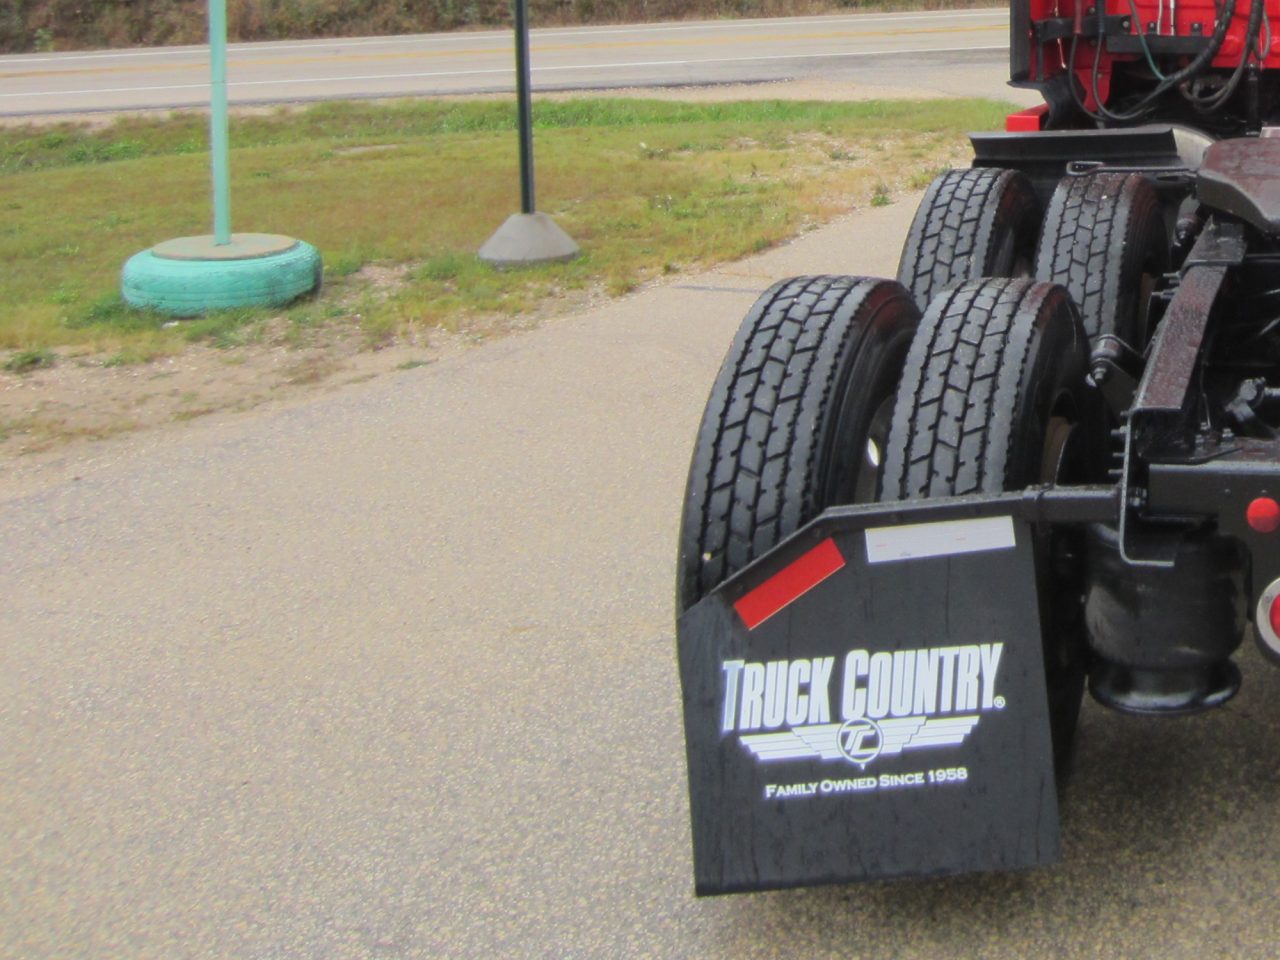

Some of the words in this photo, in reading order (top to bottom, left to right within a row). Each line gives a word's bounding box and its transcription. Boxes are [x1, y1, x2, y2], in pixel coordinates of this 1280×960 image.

[722, 656, 835, 731] TRUCK
[765, 781, 818, 798] FAMILY
[820, 777, 877, 793] OWNED
[879, 771, 925, 787] SINCE
[928, 767, 968, 783] 1958
